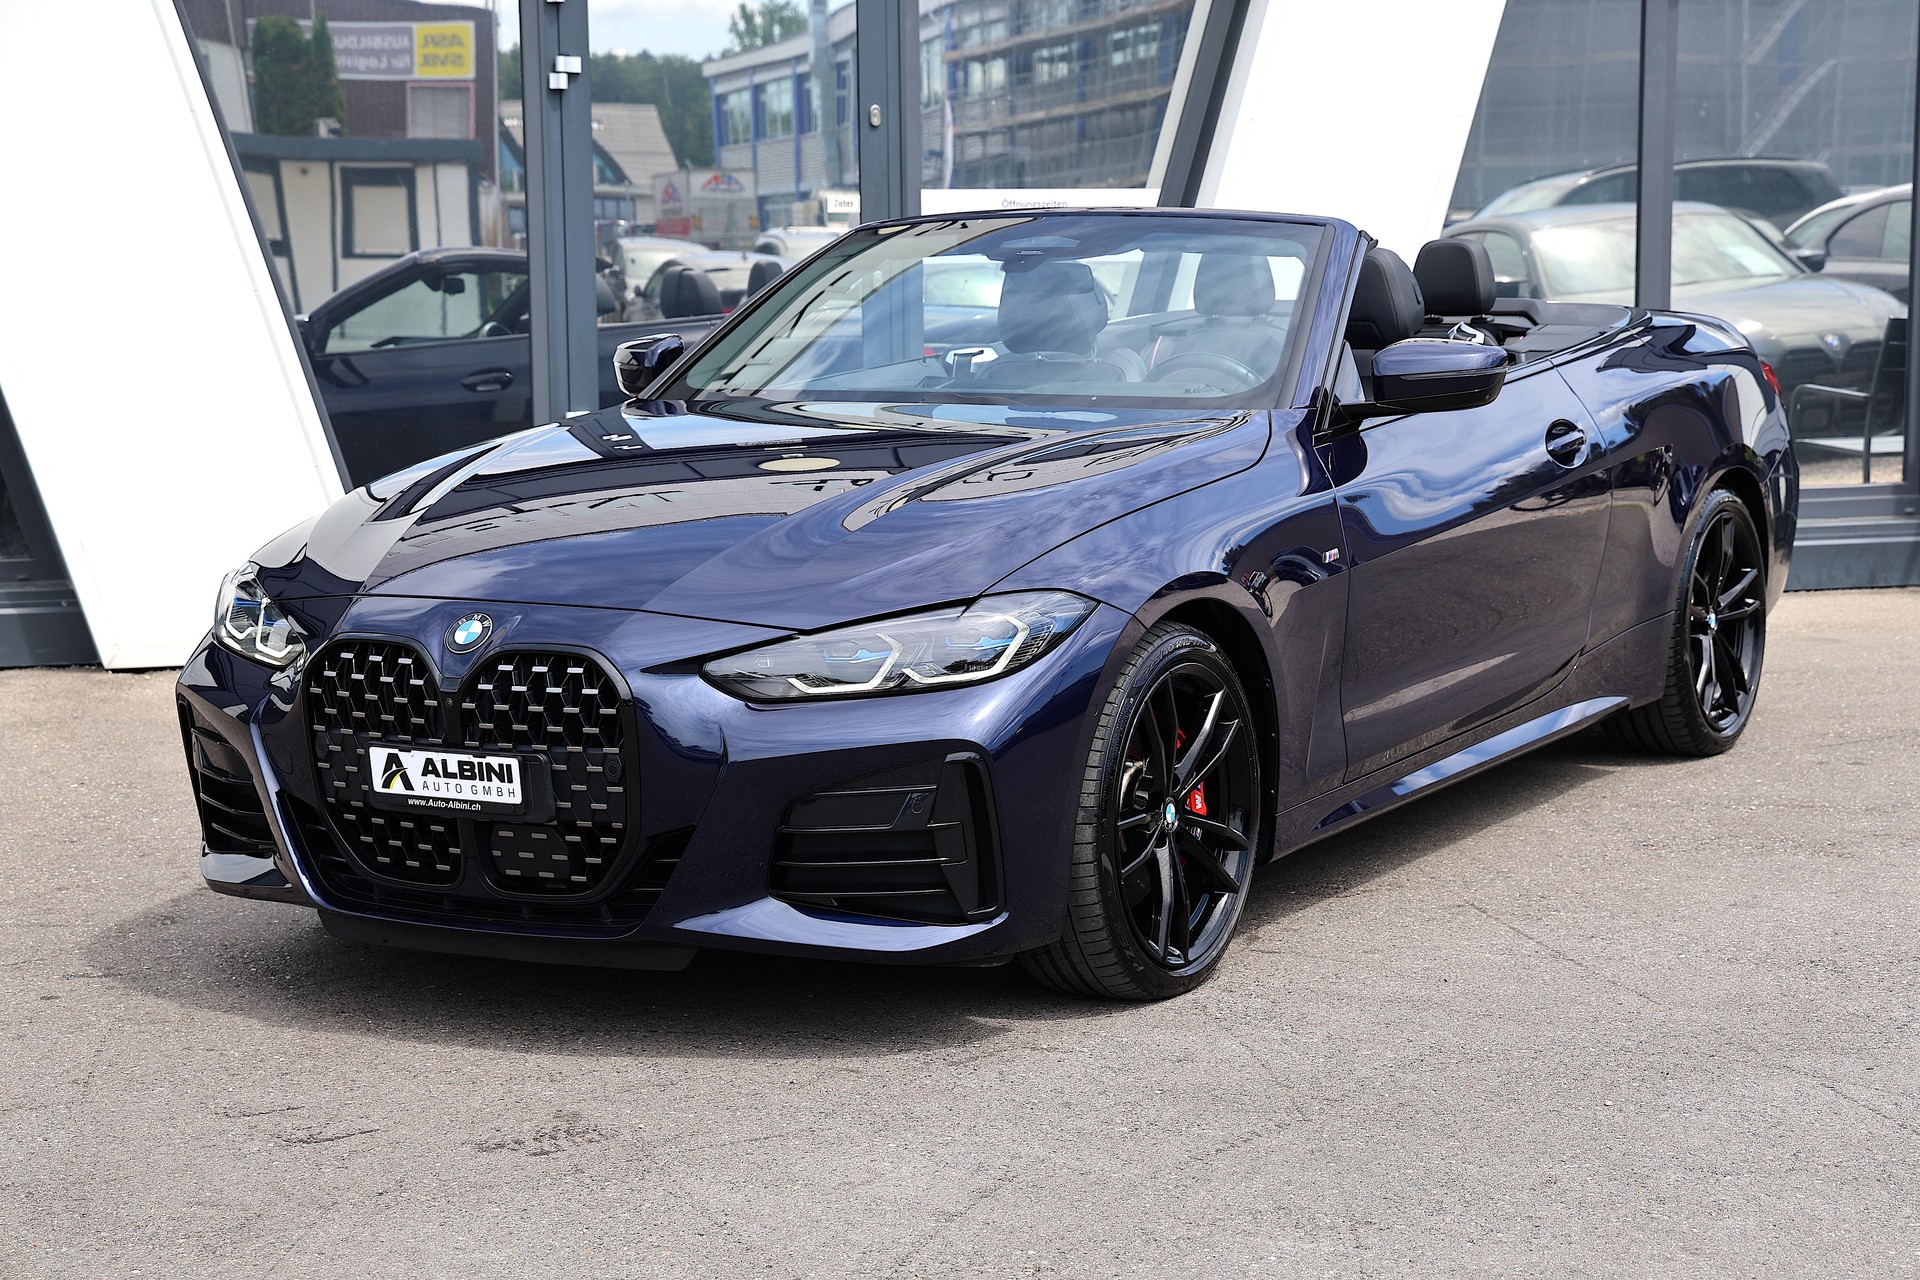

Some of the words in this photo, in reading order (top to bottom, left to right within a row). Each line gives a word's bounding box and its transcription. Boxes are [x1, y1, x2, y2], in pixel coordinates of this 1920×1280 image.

[834, 198, 854, 208] Ziehen
[1001, 198, 1068, 209] Öffnungszeiten
[421, 757, 514, 784] ALBINI
[422, 780, 464, 794] AUTO
[470, 783, 516, 798] GMBH
[407, 797, 482, 811] www.Auto-Albini.ch
